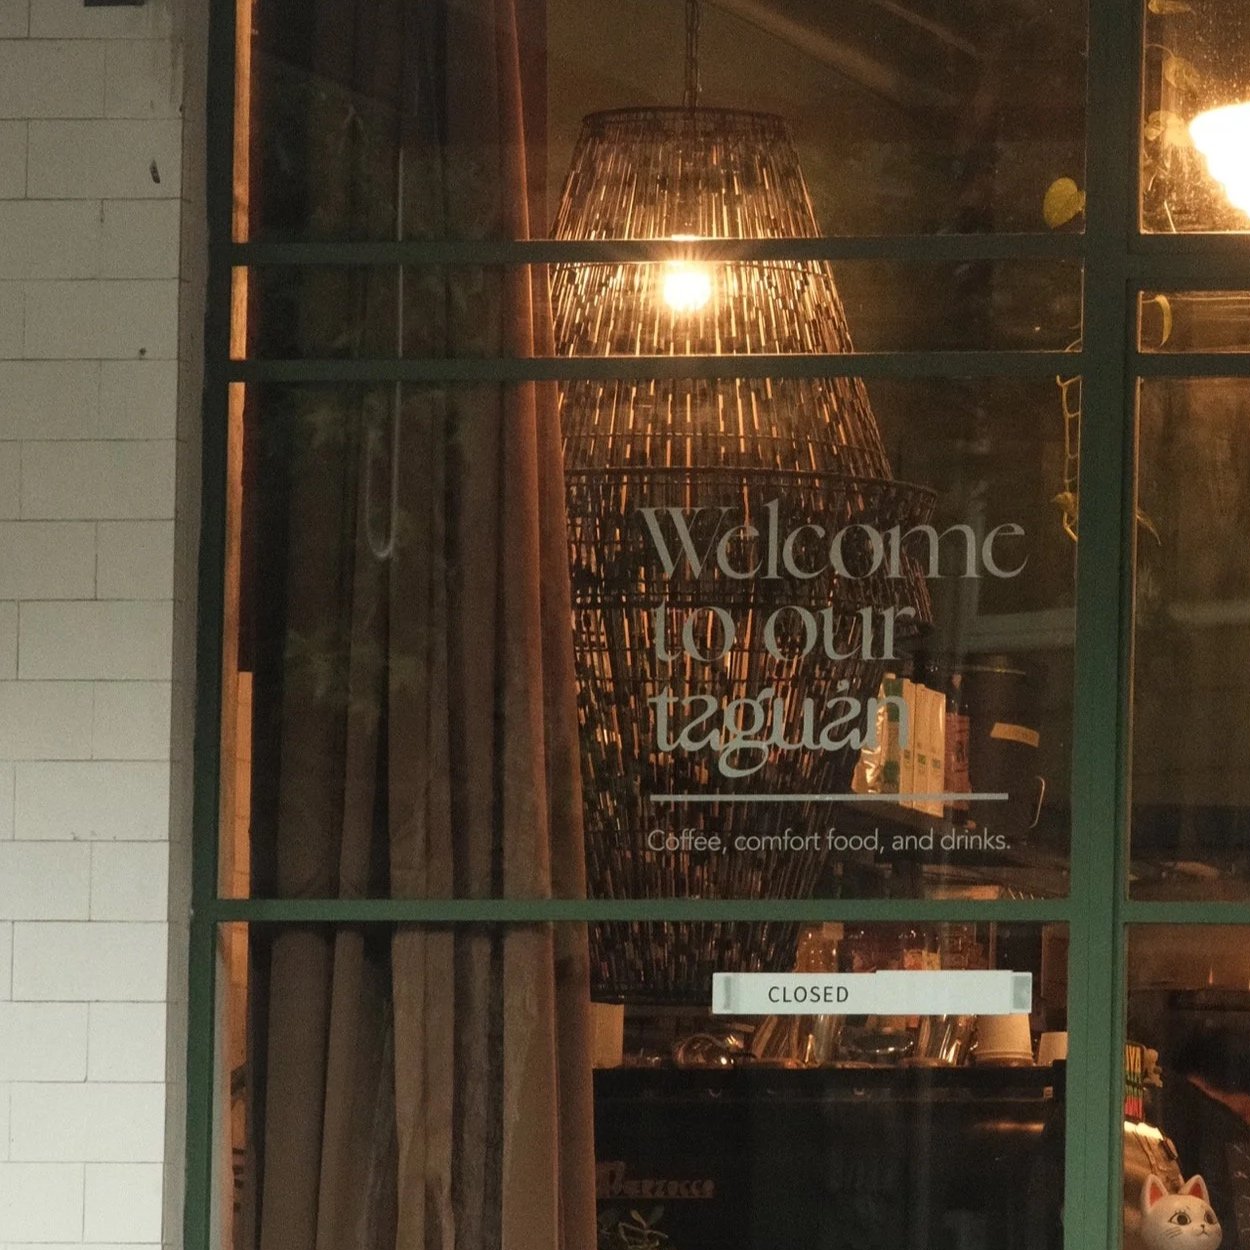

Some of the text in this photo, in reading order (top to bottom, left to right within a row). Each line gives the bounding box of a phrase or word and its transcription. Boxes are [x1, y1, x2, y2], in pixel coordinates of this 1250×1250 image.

[637, 499, 1030, 579] Welcome
[650, 599, 916, 662] to our
[647, 828, 1011, 855] Coffee, comfort food, and drinks.
[768, 986, 849, 1003] CLOSED
